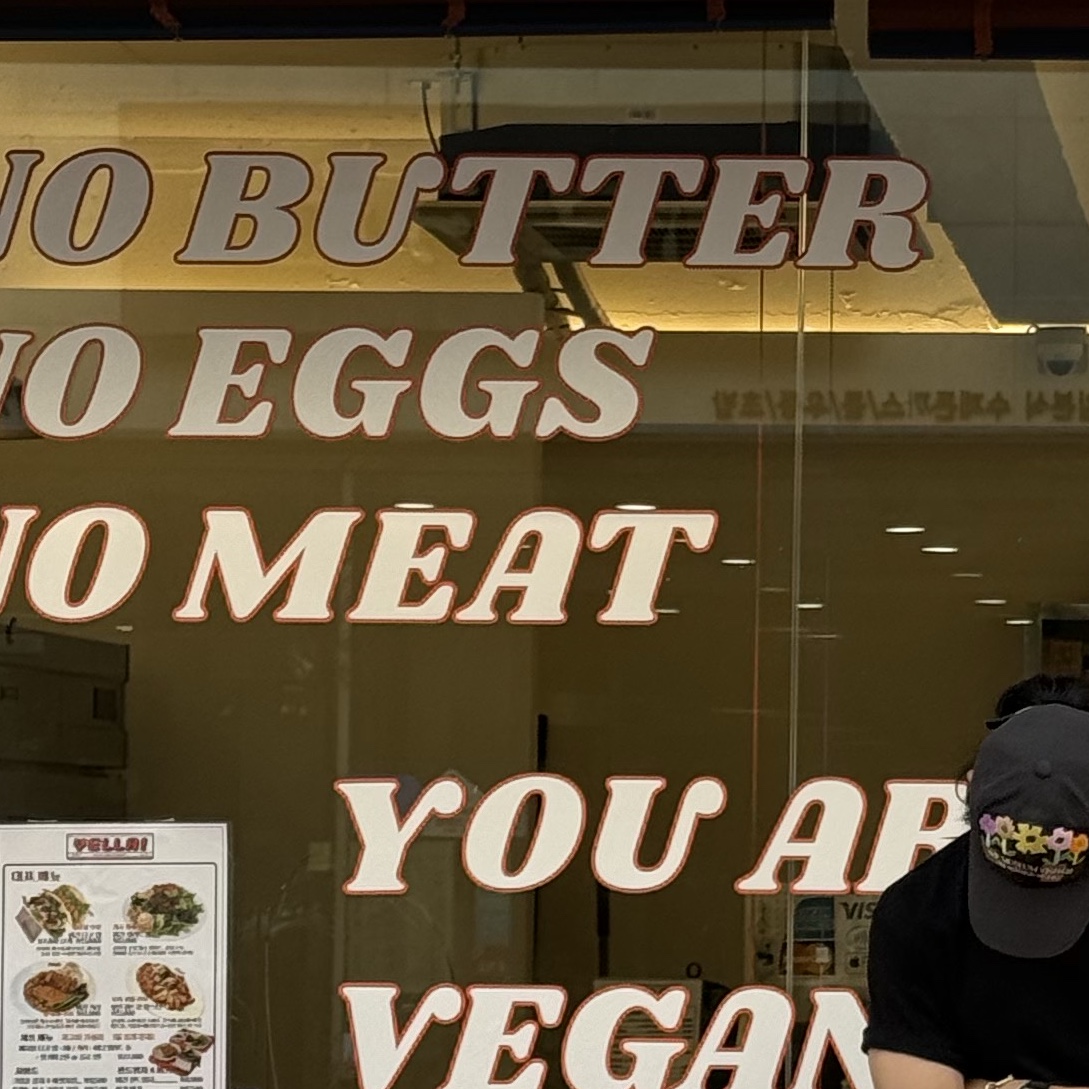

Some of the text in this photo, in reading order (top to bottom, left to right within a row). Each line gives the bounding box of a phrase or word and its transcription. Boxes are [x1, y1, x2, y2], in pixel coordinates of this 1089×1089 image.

[173, 151, 930, 272] BUTTER
[0, 323, 656, 441] O EGGS
[172, 506, 719, 624] MEAT
[333, 772, 727, 895] YOU
[733, 776, 970, 895] AR
[839, 901, 878, 920] VIS
